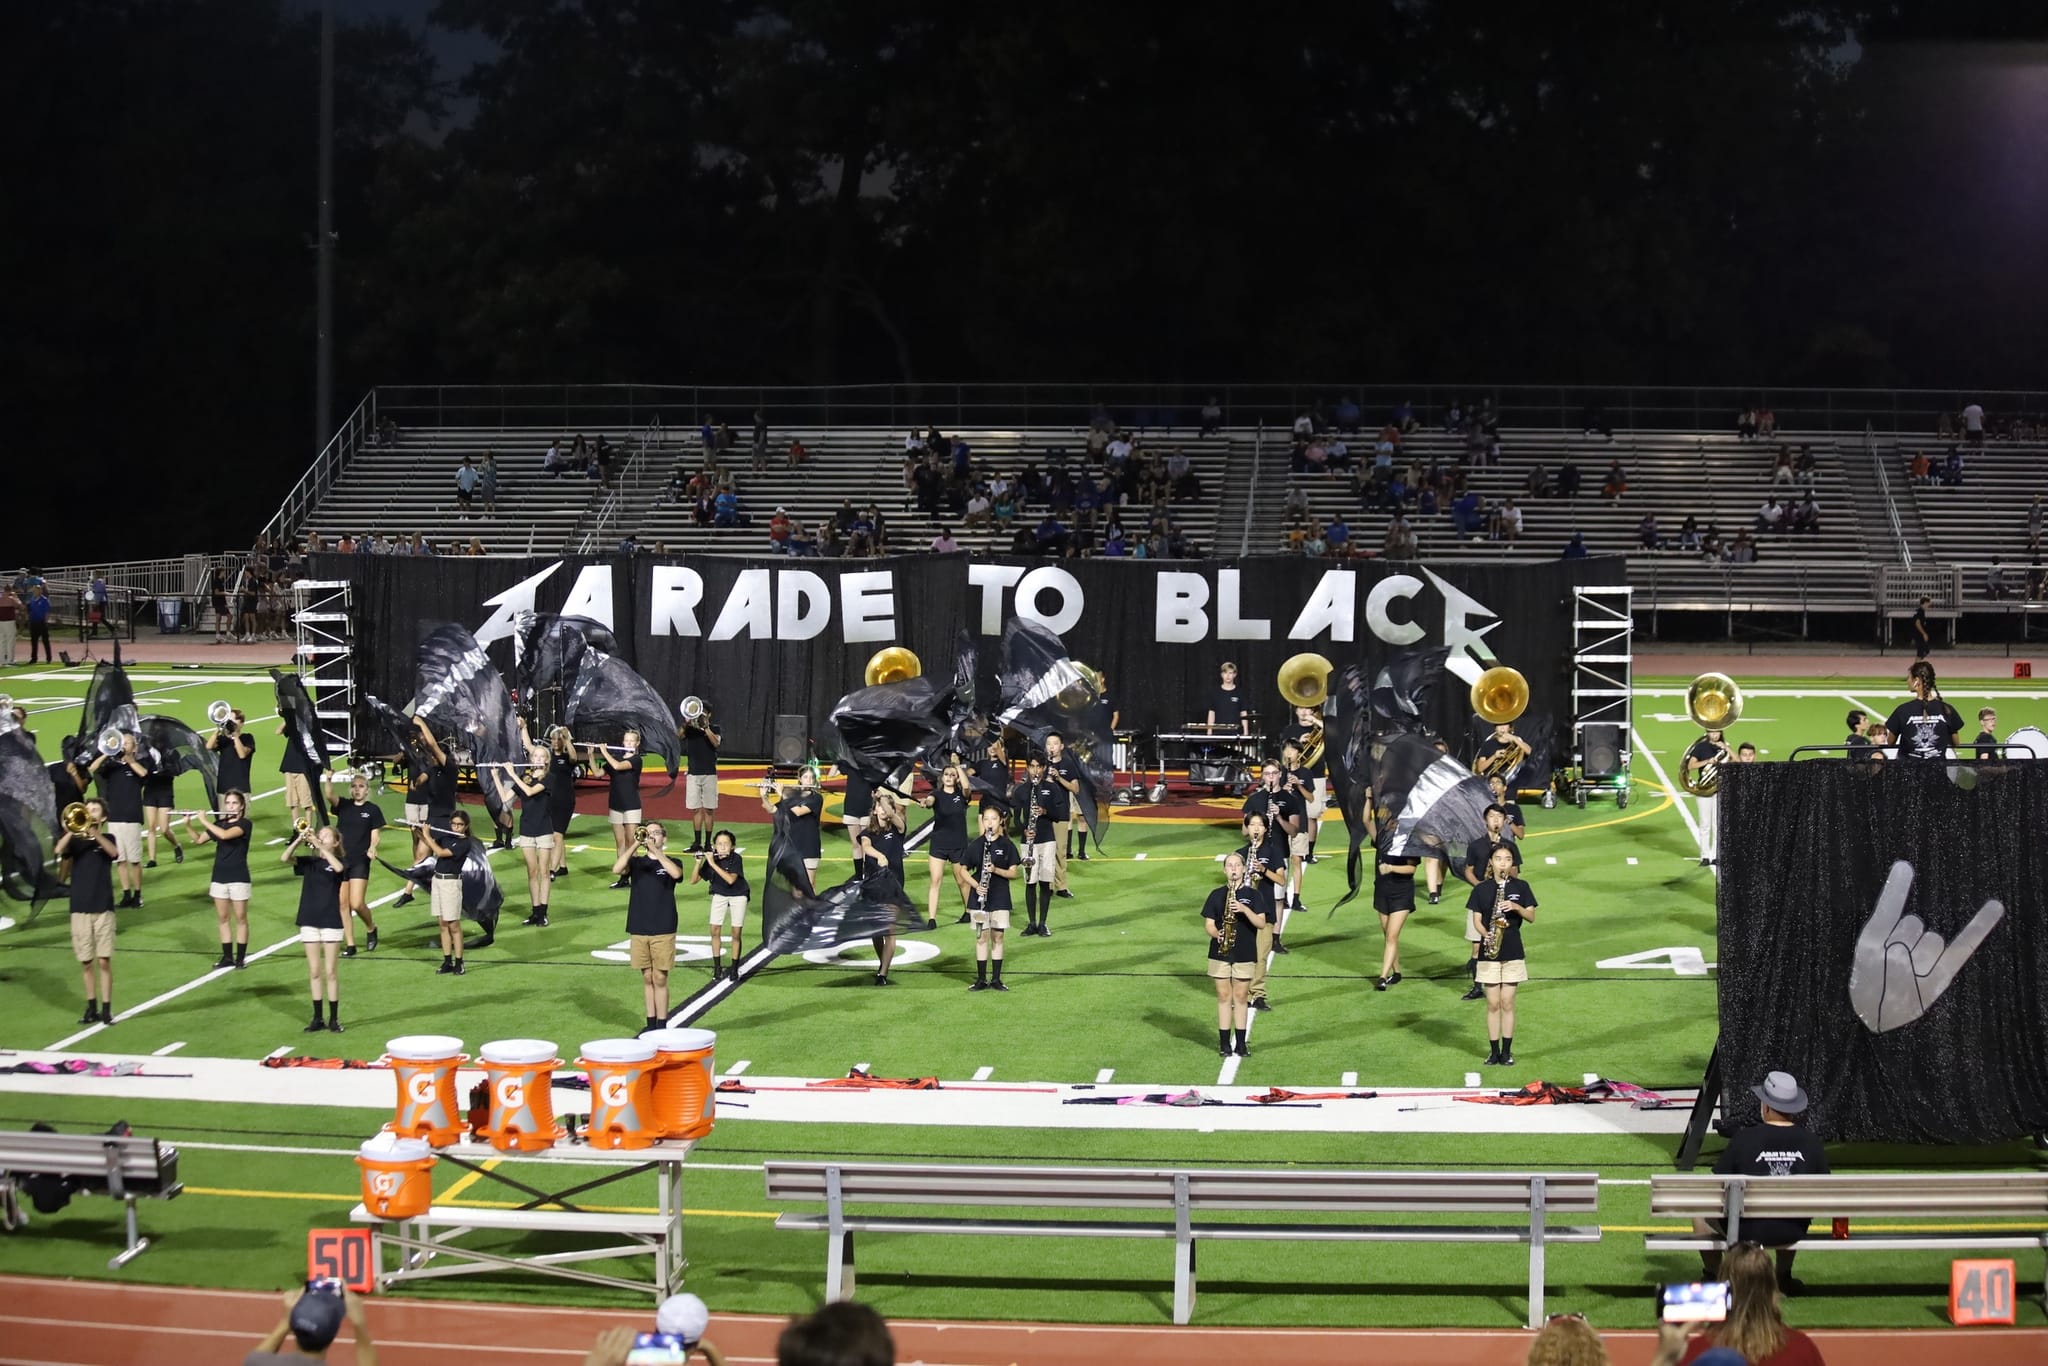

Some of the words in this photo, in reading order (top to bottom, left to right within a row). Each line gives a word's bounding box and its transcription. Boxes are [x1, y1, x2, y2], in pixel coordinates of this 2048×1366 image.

[969, 563, 1085, 645] TO
[1156, 565, 1503, 687] BLACK
[2016, 662, 2032, 677] 30
[408, 1072, 436, 1105] G
[497, 1077, 523, 1107] G
[600, 1076, 628, 1107] G
[315, 1237, 364, 1284] 50
[1958, 1269, 2011, 1318] 40
